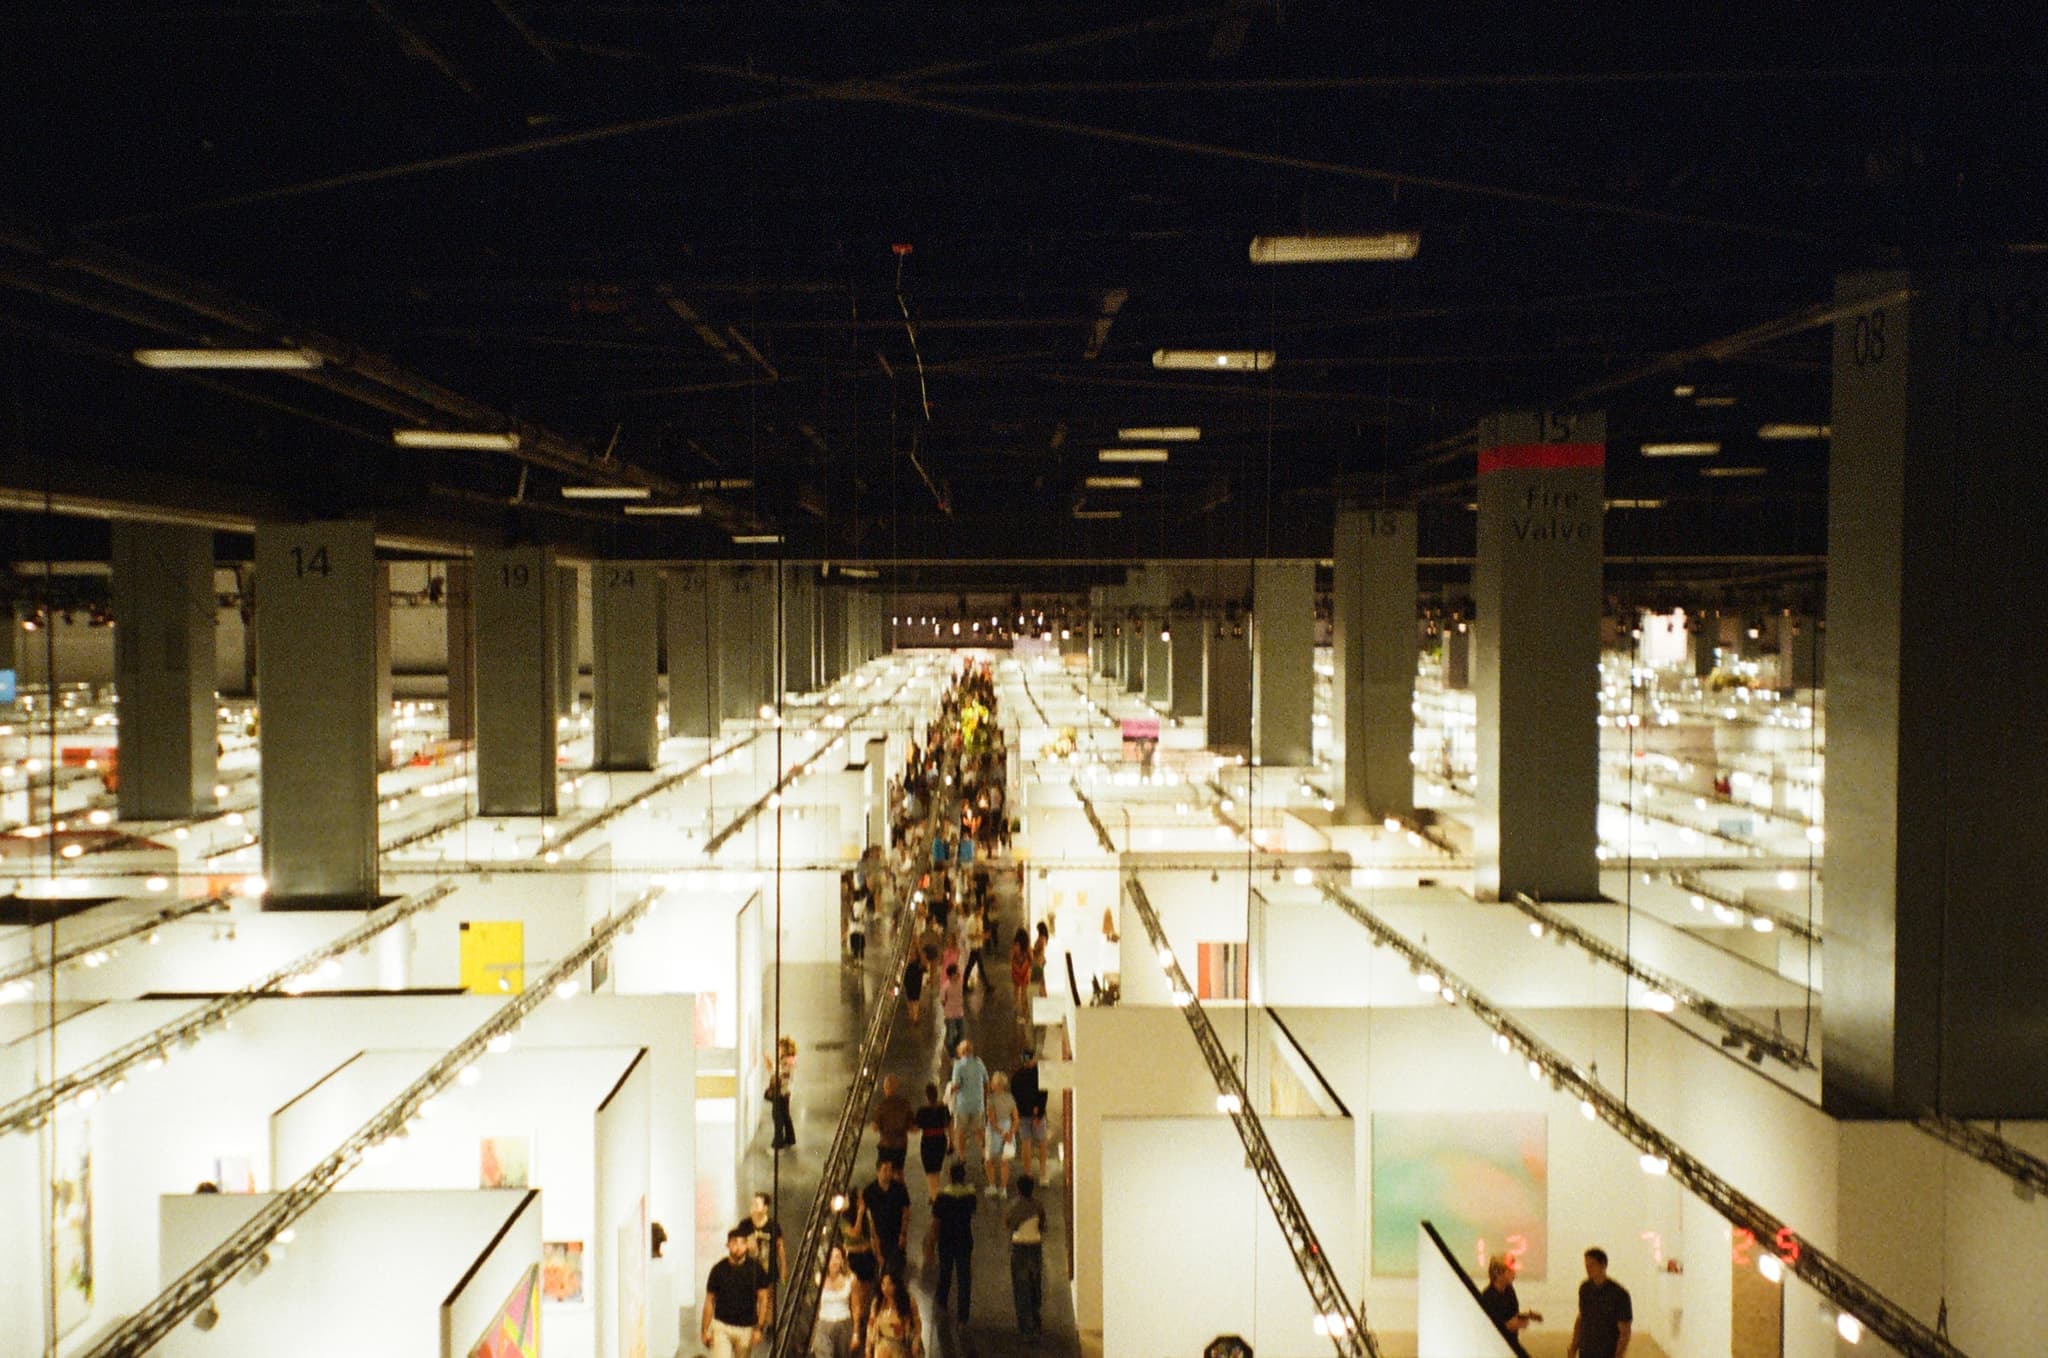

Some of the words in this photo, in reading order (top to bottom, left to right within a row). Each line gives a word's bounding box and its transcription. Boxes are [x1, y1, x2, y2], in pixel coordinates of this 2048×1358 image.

[1854, 309, 1885, 367] 08
[1533, 410, 1571, 444] 15
[1526, 486, 1580, 511] Fire
[1512, 517, 1593, 543] Valve
[290, 545, 333, 580] 14
[502, 563, 530, 589] 19
[607, 568, 635, 588] 24
